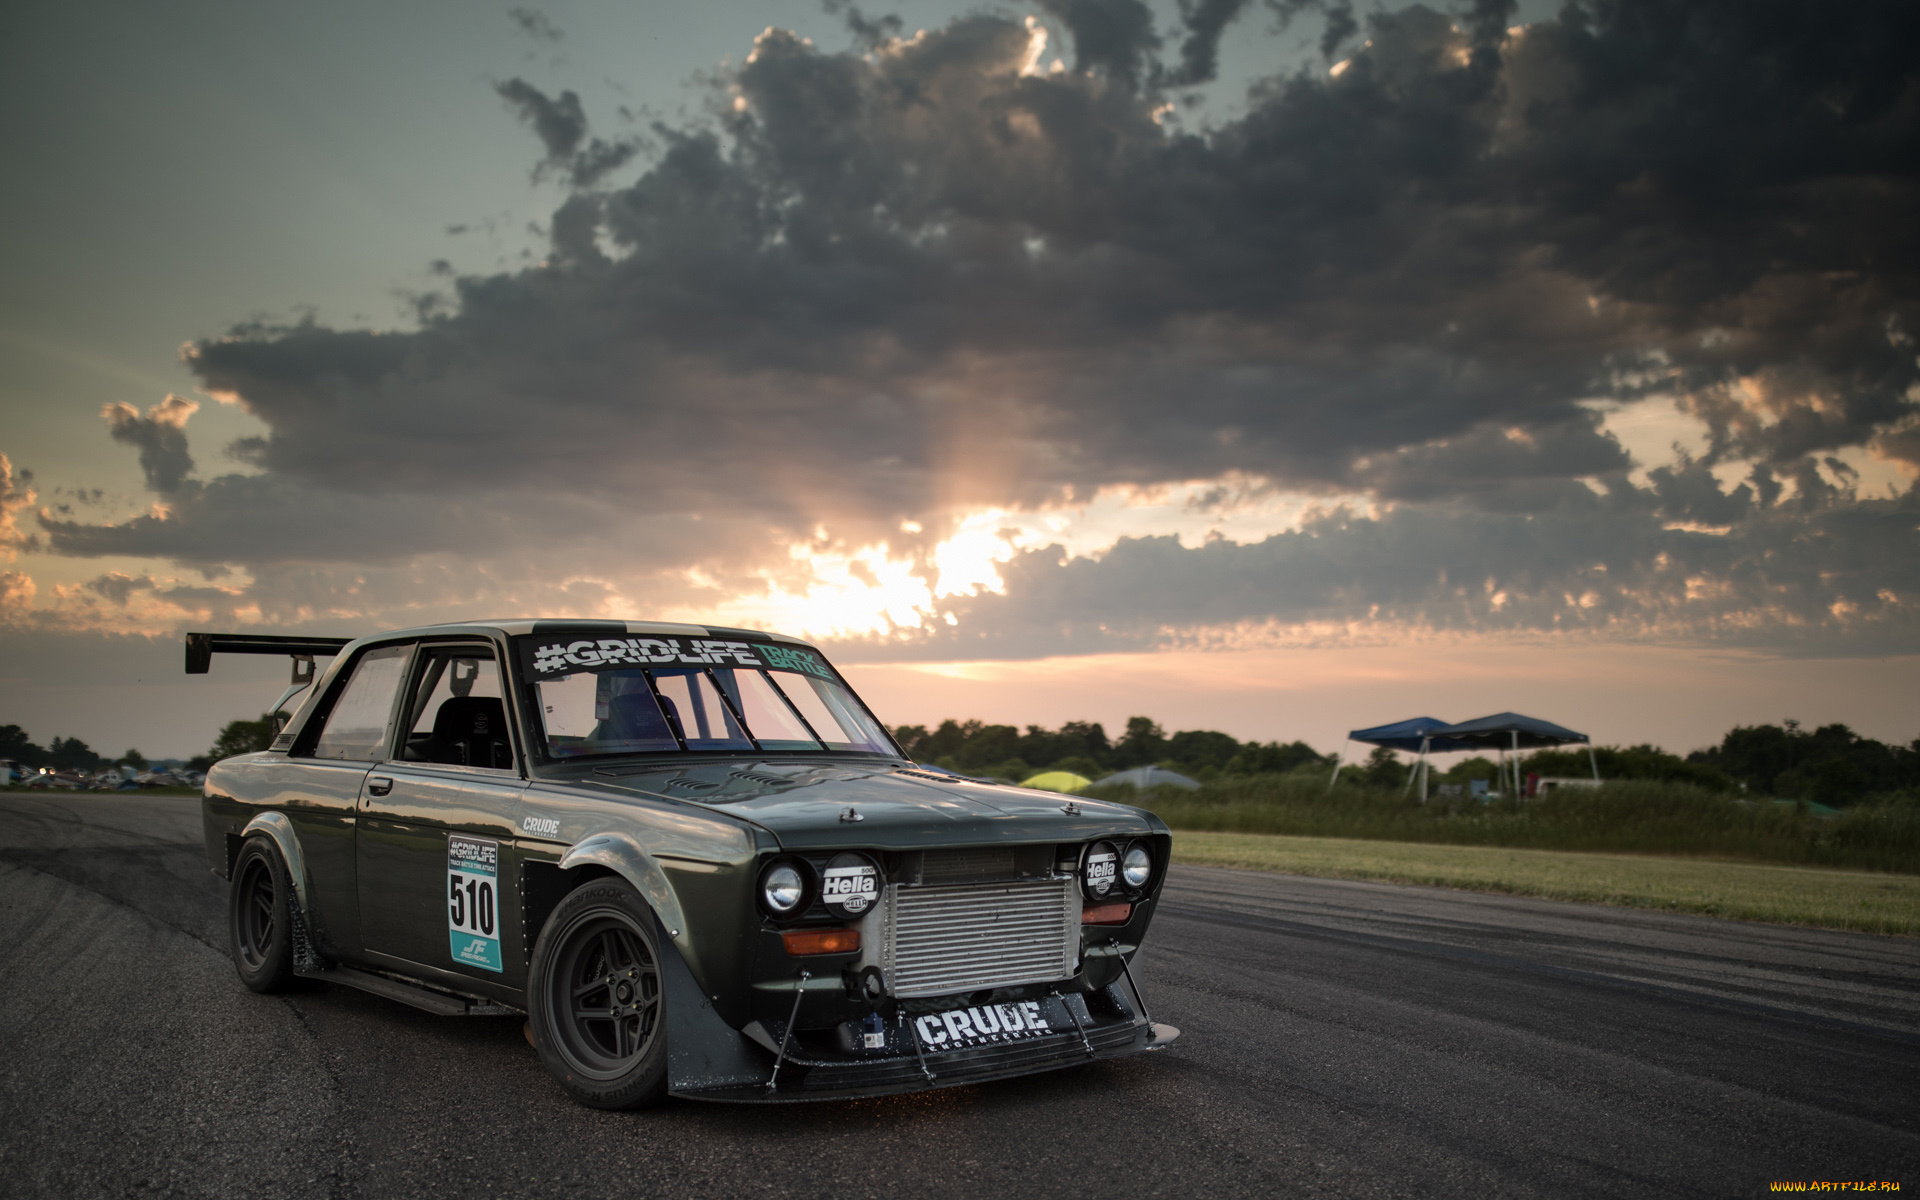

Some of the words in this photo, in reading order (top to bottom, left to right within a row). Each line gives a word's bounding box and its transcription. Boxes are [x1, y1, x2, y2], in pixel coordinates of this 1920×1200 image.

[533, 639, 762, 673] #GRIDLIFE
[750, 643, 816, 663] TRACK
[767, 656, 834, 680] BATTLE
[523, 816, 560, 834] CRUDE
[450, 842, 496, 864] #GRIDLIFE
[450, 859, 461, 867] TRACK
[461, 861, 474, 869] BATTLE
[482, 865, 496, 873] ATTACK
[1087, 861, 1115, 878] Hella
[823, 875, 875, 895] Hella
[451, 873, 494, 936] 510
[916, 1001, 1049, 1045] CRUDE
[928, 1029, 1053, 1052] ENGINEERING
